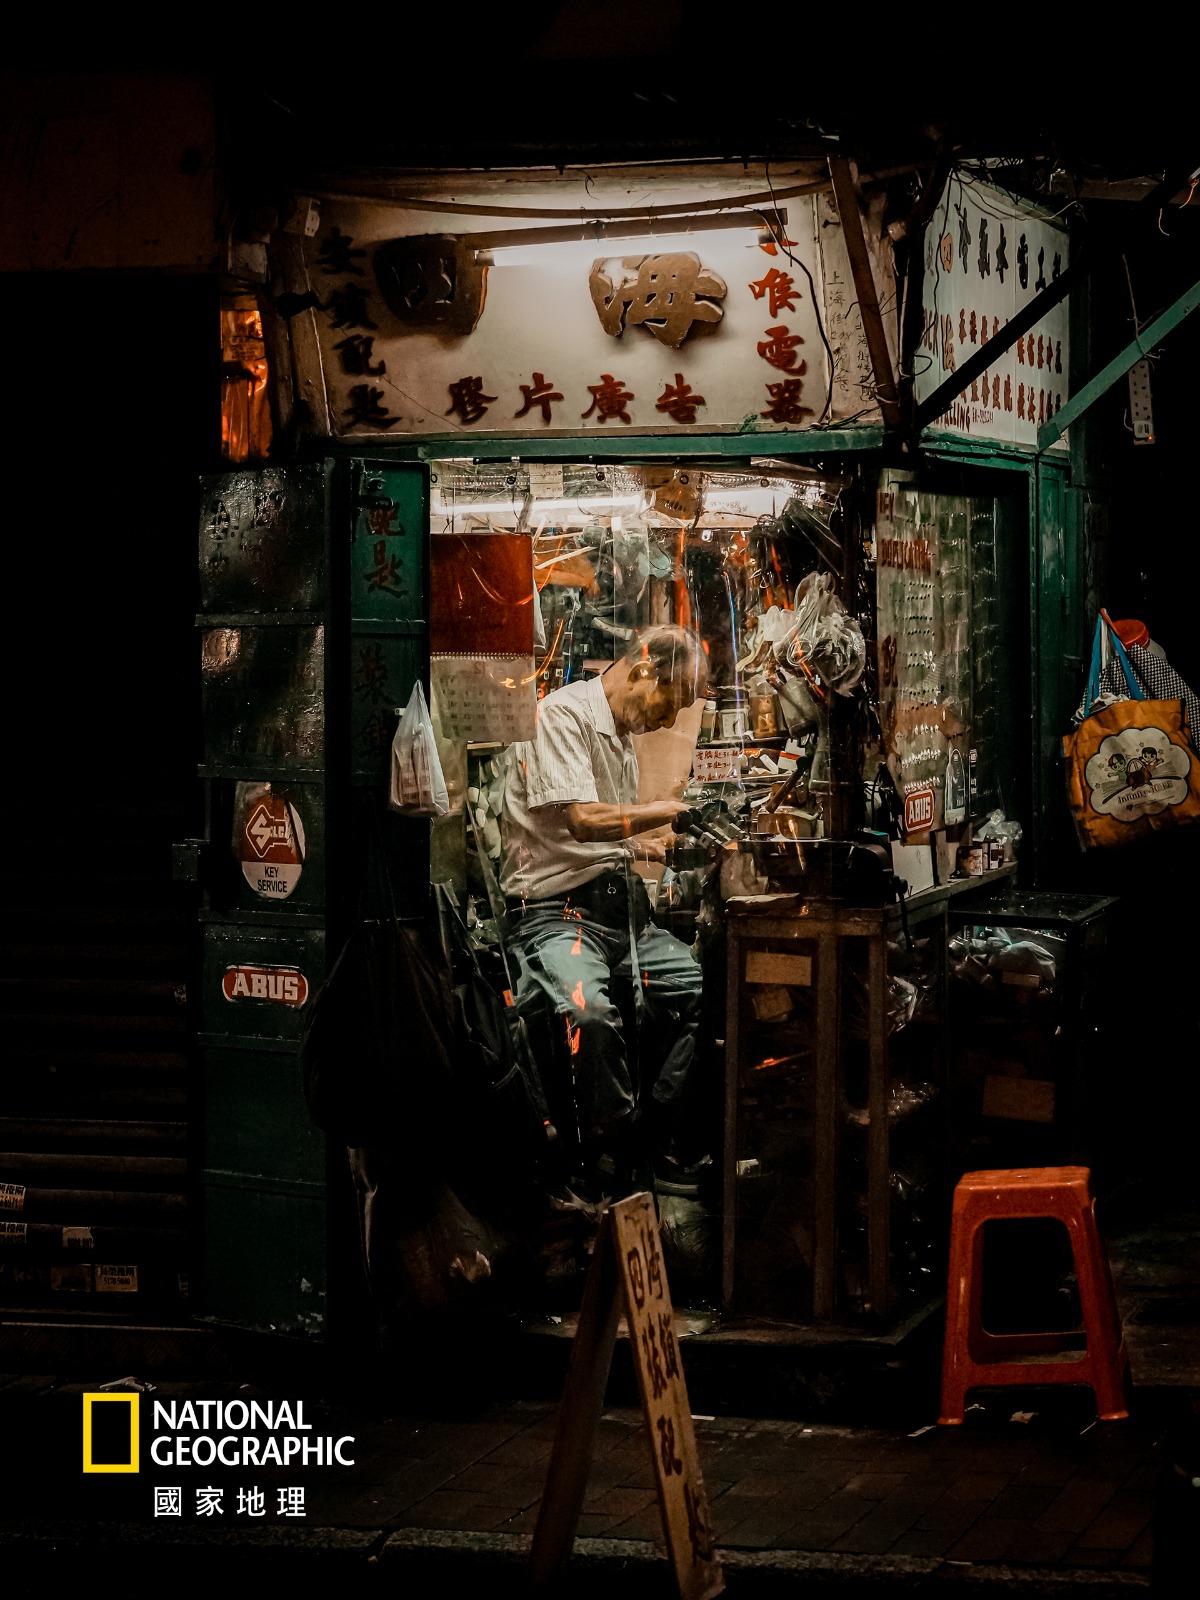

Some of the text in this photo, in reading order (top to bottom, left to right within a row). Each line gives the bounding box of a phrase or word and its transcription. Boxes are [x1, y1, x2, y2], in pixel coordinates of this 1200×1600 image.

[445, 371, 707, 425] 膠片廣告
[908, 796, 931, 825] ABUS
[257, 880, 288, 893] SERVICE
[264, 866, 279, 878] KEY
[231, 972, 299, 1001] ABUS
